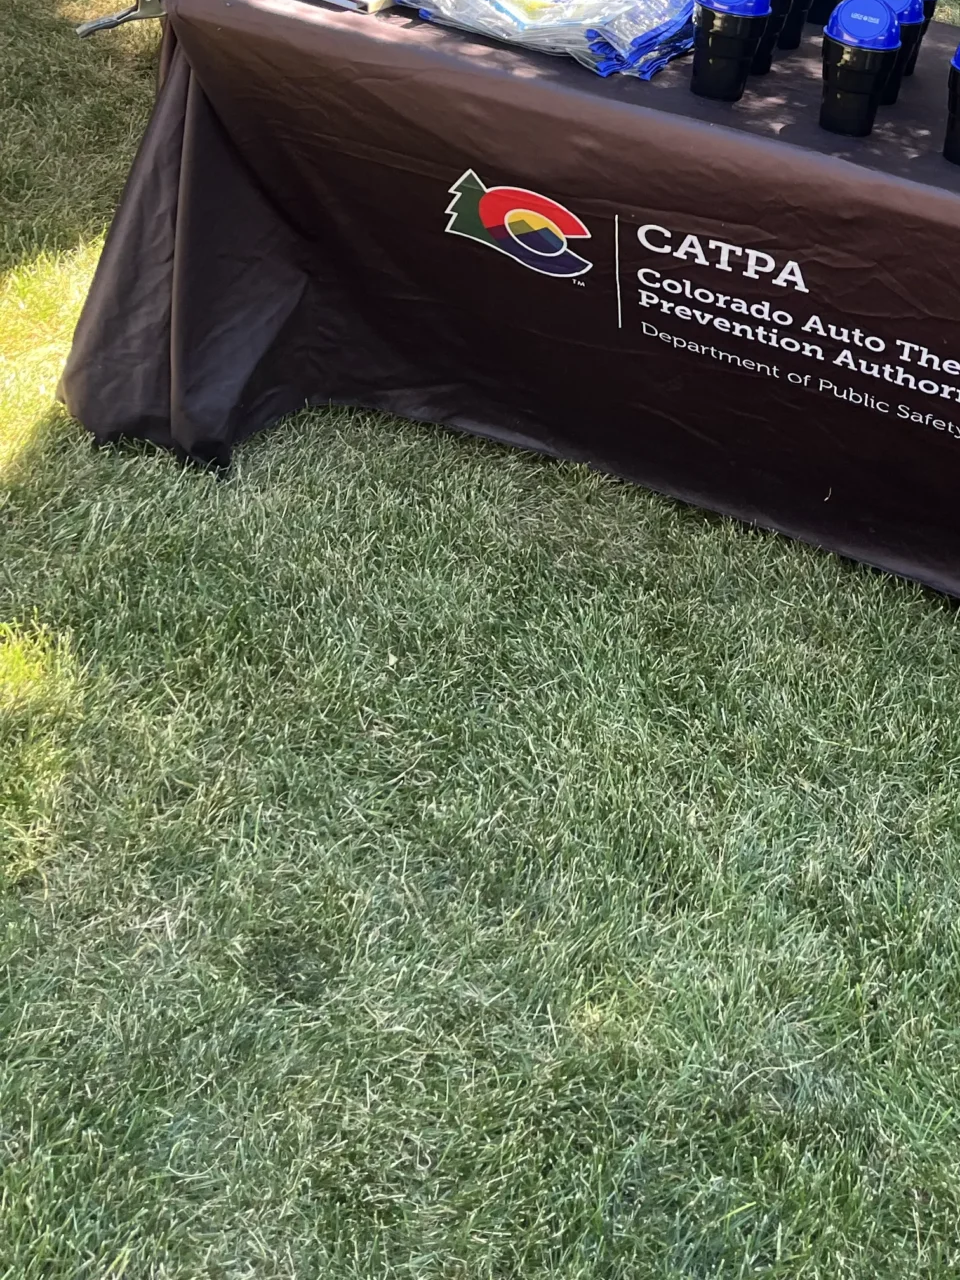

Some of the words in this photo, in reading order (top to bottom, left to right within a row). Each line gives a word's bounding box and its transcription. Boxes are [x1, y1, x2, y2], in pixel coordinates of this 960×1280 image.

[636, 224, 809, 293] CATPA
[636, 267, 793, 326] Colorado
[801, 313, 885, 353] Auto
[637, 289, 824, 361] Prevention
[641, 321, 780, 380] Department
[787, 370, 812, 387] of
[818, 378, 890, 415] Public
